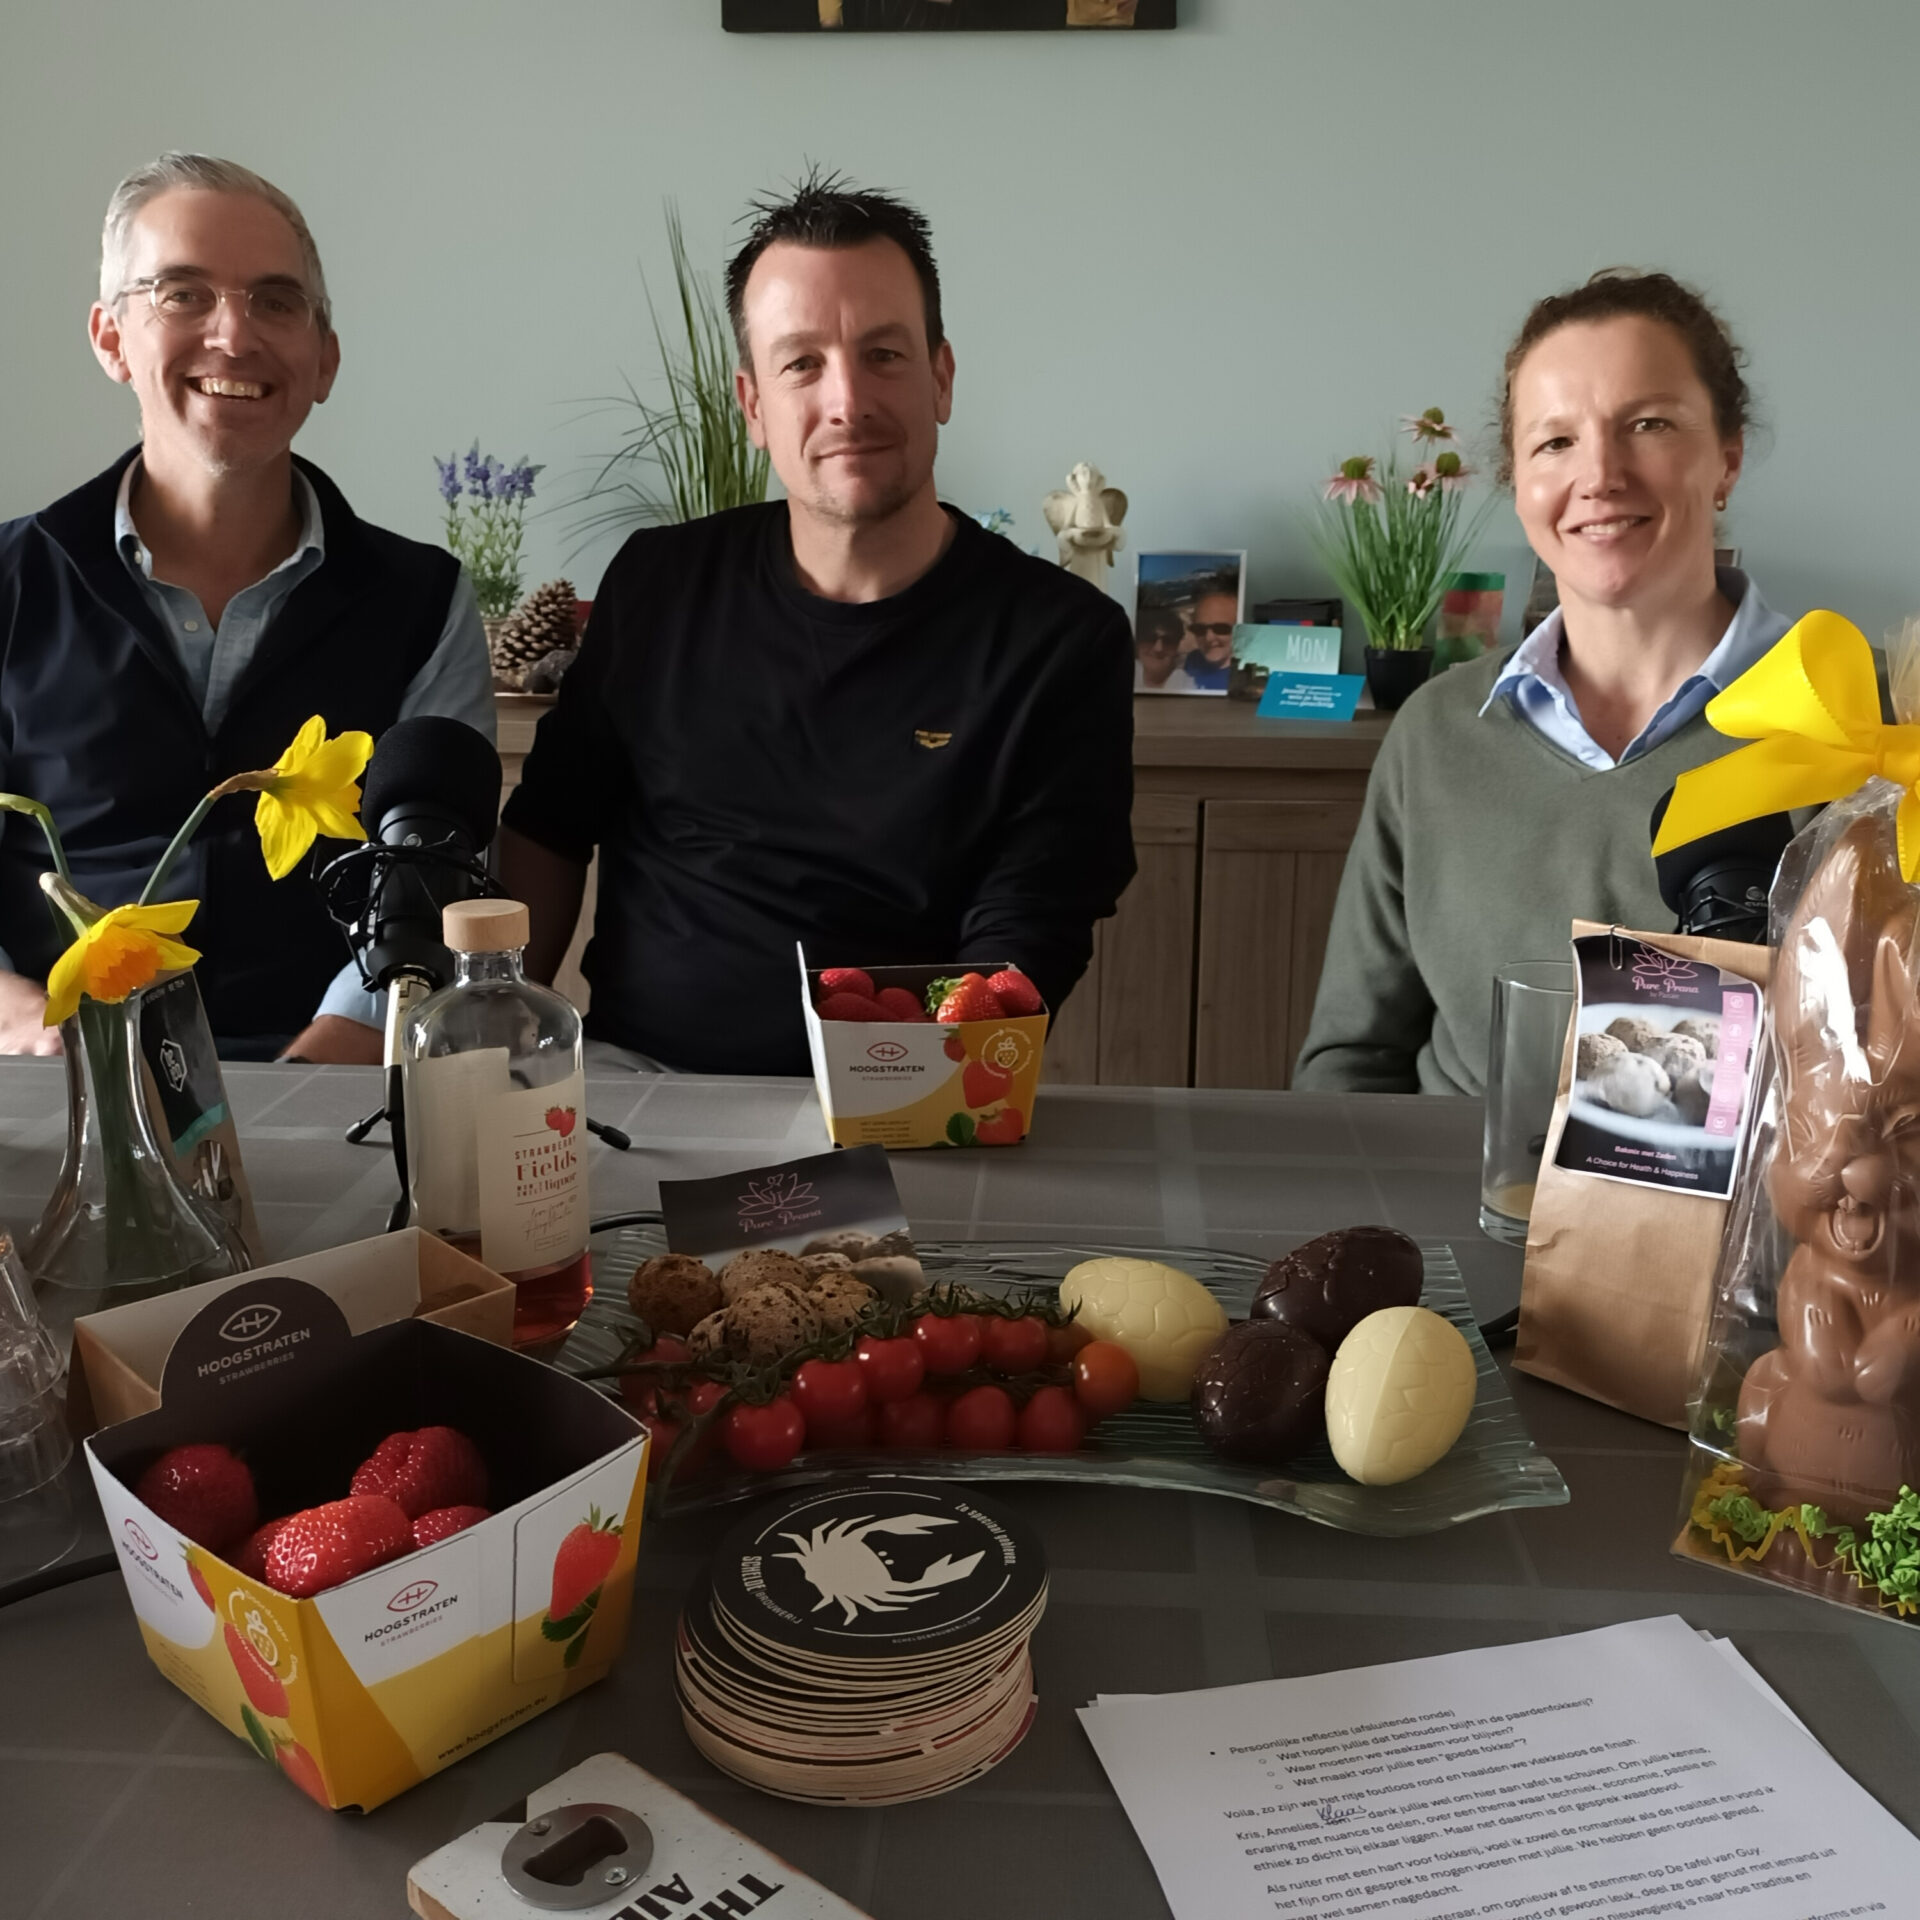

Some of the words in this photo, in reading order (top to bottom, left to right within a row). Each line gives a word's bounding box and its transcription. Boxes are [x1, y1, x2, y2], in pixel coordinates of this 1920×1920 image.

[1632, 975, 1661, 991] Pure
[1663, 978, 1700, 993] Prana
[849, 1065, 925, 1073] HOOGSTRATEN
[514, 1135, 576, 1160] STRAWBERRY
[516, 1150, 577, 1181] Fields
[1593, 1157, 1618, 1167] Choice
[1618, 1161, 1630, 1169] for
[1629, 1163, 1653, 1173] Health
[1661, 1168, 1700, 1180] Happiness
[738, 1217, 774, 1233] Pure
[197, 1328, 311, 1377] HOOGSTRATEN
[219, 1351, 295, 1385] STRAWBERRIES
[954, 1502, 970, 1513] Zo
[741, 1555, 766, 1592] SCHELDE
[755, 1591, 803, 1625] BROUWERIJ
[364, 1594, 458, 1642] HOOGSTRATEN
[1228, 1738, 1301, 1755] Persoonlijke
[1301, 1729, 1350, 1743] reflectie
[1349, 1716, 1418, 1736] (afsluitende
[1418, 1709, 1456, 1722] ronde)
[1275, 1751, 1302, 1761] Wat
[1301, 1745, 1341, 1757] hopen
[1340, 1739, 1371, 1752] jullie
[1371, 1735, 1392, 1745] dat
[1390, 1725, 1450, 1741] behouden
[1448, 1720, 1477, 1730] blijft
[1489, 1715, 1505, 1723] de
[1505, 1698, 1594, 1722] paardenfokkerij?
[1284, 1763, 1316, 1774] Waar
[1318, 1755, 1364, 1768] moeten
[1364, 1752, 1383, 1760] we
[1383, 1740, 1446, 1756] waakzaam
[1444, 1735, 1471, 1745] voor
[1471, 1726, 1514, 1740] blijven?
[1260, 1806, 1276, 1814] zo
[1277, 1802, 1299, 1812] zijn
[1299, 1799, 1319, 1808] we
[1318, 1795, 1341, 1805] het
[1341, 1791, 1366, 1801] ritje
[1365, 1782, 1416, 1796] foutloos
[1416, 1775, 1445, 1787] rond
[1445, 1773, 1462, 1782] en
[1461, 1764, 1510, 1778] haalden
[1509, 1761, 1528, 1769] we
[1527, 1749, 1589, 1766] vlekkeloos
[1589, 1746, 1605, 1754] de
[1292, 1777, 1320, 1787] Wat
[1320, 1770, 1358, 1783] maakt
[1358, 1765, 1385, 1776] voor
[1385, 1760, 1415, 1773] jullie
[1416, 1756, 1439, 1765] een
[1235, 1831, 1265, 1841] Kris,
[1266, 1822, 1324, 1837] Annelies,
[1367, 1807, 1399, 1819] dank
[1398, 1802, 1430, 1814] jullie
[1429, 1796, 1453, 1807] wel
[1452, 1793, 1474, 1803] om
[1472, 1789, 1497, 1799] hier
[1498, 1784, 1522, 1794] aan
[1521, 1778, 1550, 1790] tafel
[1548, 1776, 1563, 1784] te
[1618, 1760, 1642, 1770] Om
[1641, 1754, 1670, 1767] jullie
[1244, 1841, 1298, 1856] ervaring
[1296, 1836, 1324, 1848] met
[1323, 1828, 1371, 1843] nuance
[1370, 1826, 1385, 1834] te
[1386, 1819, 1426, 1831] delen,
[1426, 1812, 1451, 1824] over
[1453, 1808, 1477, 1818] een
[1476, 1800, 1517, 1814] thema
[1516, 1794, 1546, 1806] waar
[1546, 1784, 1603, 1800] techniek,
[1602, 1771, 1664, 1789] economie,
[1663, 1763, 1701, 1777] passie
[1700, 1760, 1717, 1768] en
[1253, 1858, 1294, 1871] ethiek
[1294, 1856, 1310, 1865] zo
[1311, 1849, 1344, 1862] dicht
[1343, 1846, 1363, 1855] bij
[1362, 1838, 1400, 1852] elkaar
[1401, 1831, 1443, 1845] liggen.
[1442, 1824, 1474, 1836] Maar
[1476, 1819, 1498, 1830] net
[1498, 1810, 1545, 1825] daarom
[1545, 1808, 1557, 1816] is
[1557, 1804, 1575, 1814] dit
[1575, 1795, 1621, 1812] gesprek
[1267, 1884, 1288, 1894] Als
[1288, 1878, 1323, 1890] ruiter
[1324, 1872, 1352, 1884] met
[1352, 1867, 1378, 1878] een
[1377, 1861, 1405, 1873] hart
[1404, 1856, 1433, 1868] voor
[1433, 1846, 1485, 1862] fokkerij,
[1484, 1839, 1512, 1852] voel
[1510, 1838, 1524, 1846] ik
[1524, 1829, 1561, 1844] zowel
[1560, 1828, 1578, 1836] de
[1578, 1815, 1638, 1833] romantiek
[1638, 1812, 1658, 1821] als
[1657, 1808, 1674, 1816] de
[1674, 1797, 1720, 1813] realiteit
[1719, 1795, 1736, 1803] en
[1734, 1788, 1765, 1800] vond
[1764, 1786, 1776, 1794] ik
[1274, 1899, 1298, 1910] het
[1297, 1896, 1320, 1907] fijn
[1321, 1892, 1344, 1902] om
[1344, 1887, 1364, 1898] dit
[1364, 1876, 1415, 1896] gesprek
[1414, 1874, 1429, 1883] te
[1430, 1865, 1474, 1880] mogen
[1473, 1857, 1517, 1870] voeren
[1517, 1850, 1544, 1862] met
[1576, 1839, 1600, 1849] We
[1598, 1830, 1646, 1845] hebben
[1646, 1824, 1676, 1838] geen
[1676, 1812, 1722, 1829] oordeel
[1320, 1907, 1345, 1920] wel
[1345, 1900, 1391, 1915] samen
[1391, 1885, 1464, 1905] nagedacht.
